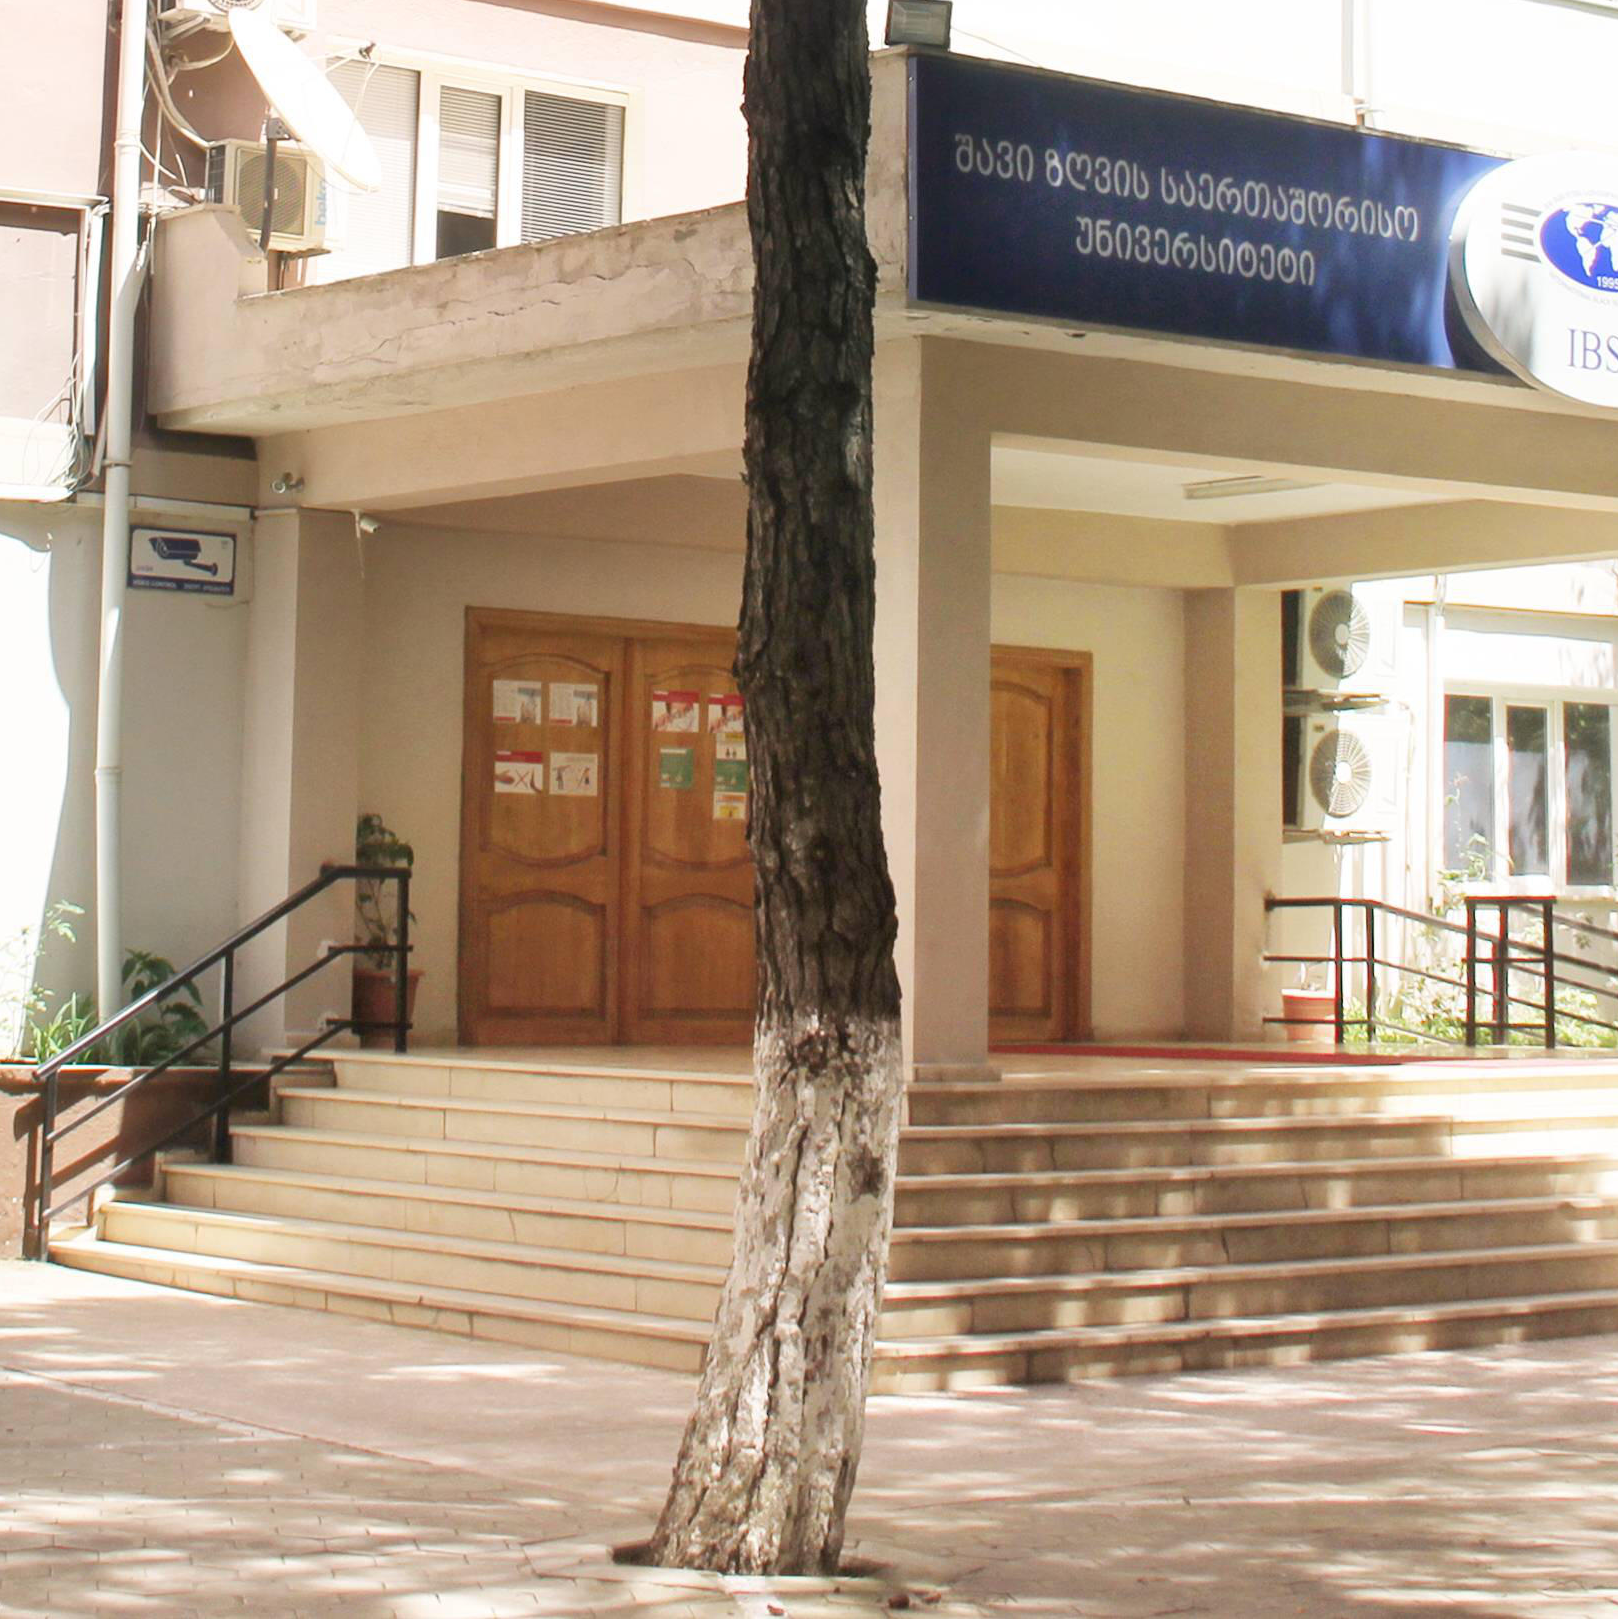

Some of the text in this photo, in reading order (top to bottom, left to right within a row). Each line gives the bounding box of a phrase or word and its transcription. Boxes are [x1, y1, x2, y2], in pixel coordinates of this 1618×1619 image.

[954, 132, 1419, 242] შავი ზღვის საერთაშორისო
[1075, 216, 1315, 286] უნივერსიტეტი
